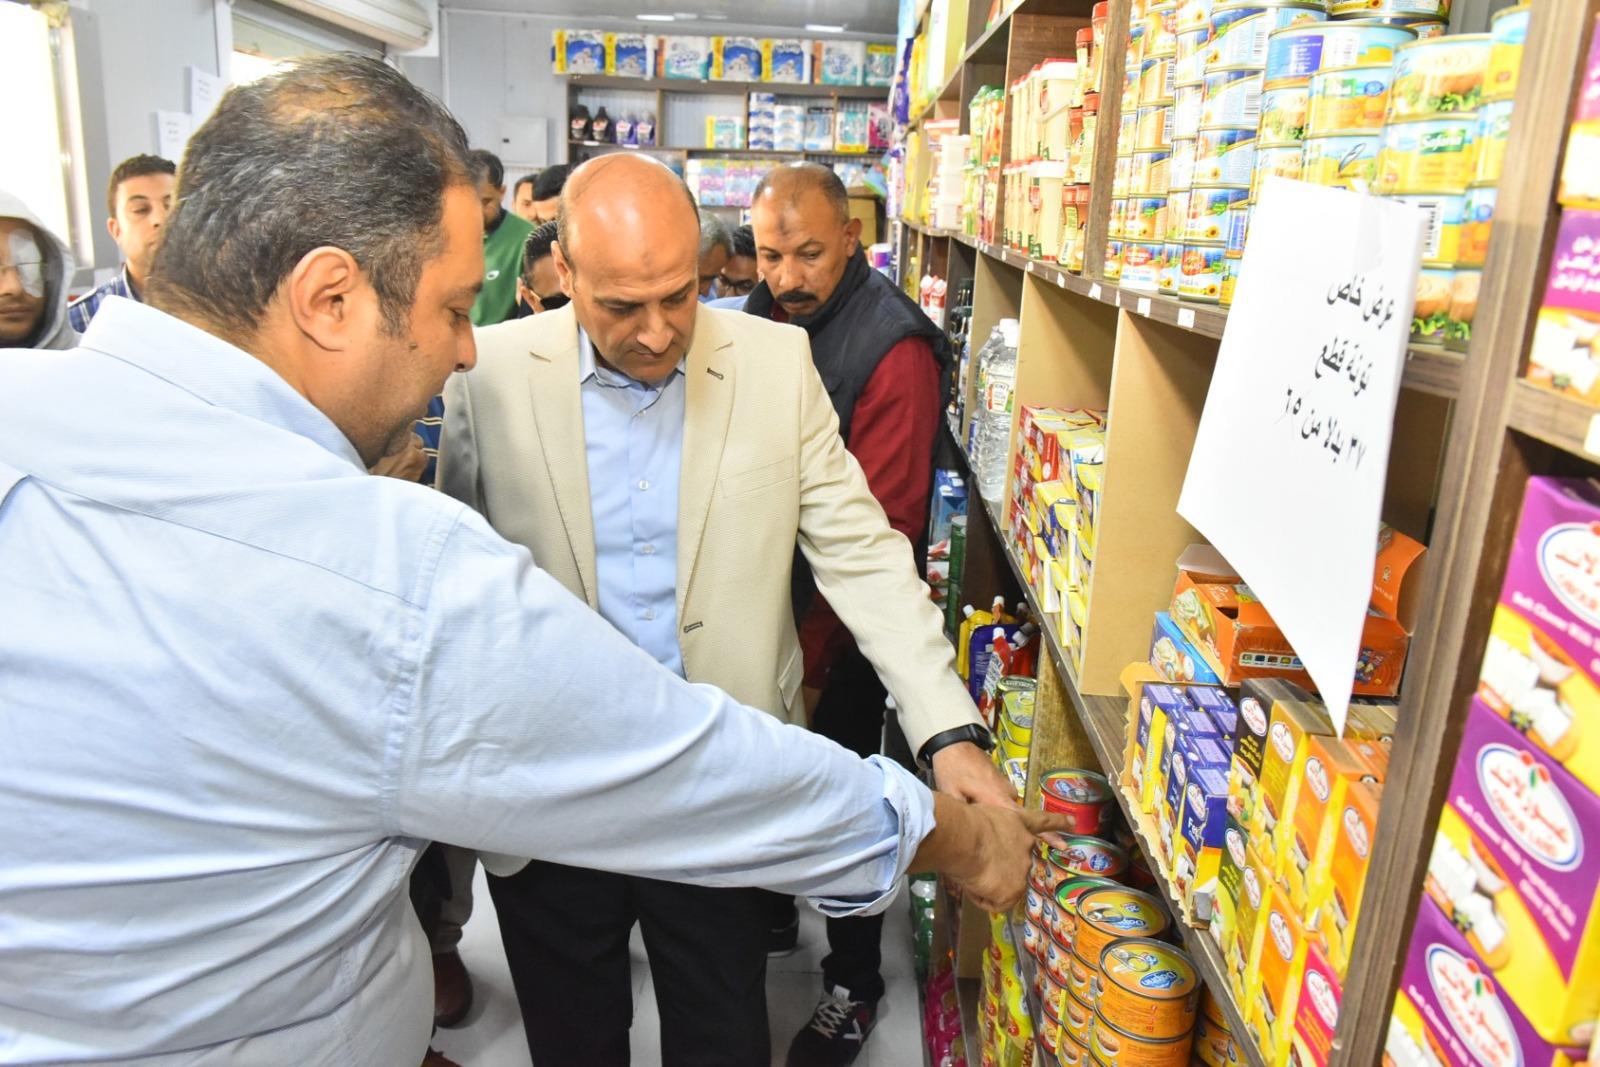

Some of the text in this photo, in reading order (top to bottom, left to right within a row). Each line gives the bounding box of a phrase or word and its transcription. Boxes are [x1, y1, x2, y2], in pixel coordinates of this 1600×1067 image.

[1326, 273, 1395, 331] عرض خاص
[1314, 335, 1349, 380] قطع
[1300, 408, 1322, 440] من
